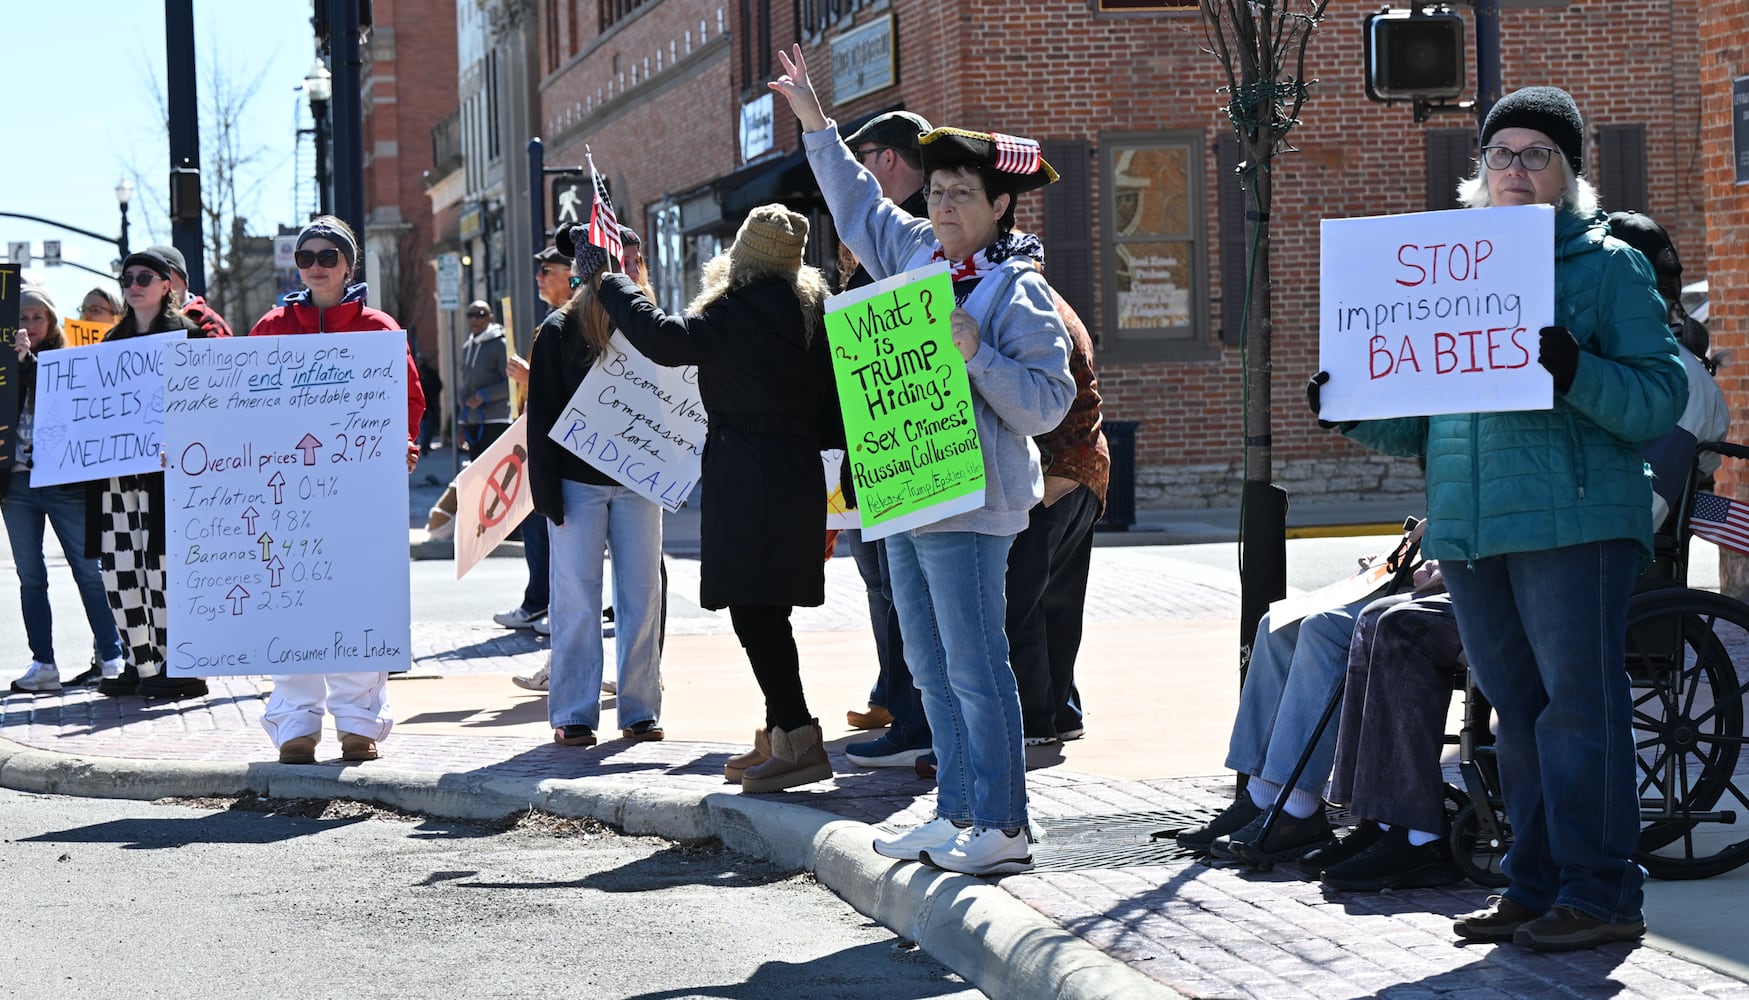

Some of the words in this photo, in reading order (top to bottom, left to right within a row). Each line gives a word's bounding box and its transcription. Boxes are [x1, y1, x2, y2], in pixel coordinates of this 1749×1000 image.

[1396, 239, 1493, 287] STOP
[844, 291, 913, 343] What
[1338, 288, 1521, 343] imprisoning
[267, 337, 305, 370] day
[851, 340, 937, 392] TRUMP
[874, 338, 895, 357] is
[1369, 327, 1529, 380] BABIES
[42, 357, 88, 393] THE
[167, 375, 200, 393] we
[208, 367, 243, 389] will
[249, 366, 284, 388] end
[293, 361, 355, 386] inflation
[363, 360, 394, 379] and
[603, 352, 673, 405] Becomes
[865, 364, 952, 421] Hiding?
[72, 397, 115, 422] ICE
[120, 390, 141, 416] IS
[166, 393, 219, 412] make
[227, 391, 281, 411] America
[290, 384, 350, 409] affordable
[598, 385, 704, 456] Compassion
[863, 427, 900, 454] Sex
[903, 400, 969, 442] Crimes?
[59, 432, 160, 470] MELTING
[181, 442, 253, 476] Overall
[258, 451, 298, 474] prices
[331, 432, 384, 464] 2.9%
[563, 418, 692, 505] RADICAL!
[615, 426, 667, 463] looks
[854, 458, 914, 489] Russian
[911, 428, 979, 469] Collusion?
[183, 486, 267, 510] Inflation
[299, 475, 339, 501] 0.4%
[866, 489, 905, 513] Release
[185, 517, 243, 541] Coffee
[185, 544, 257, 566] Bananas
[282, 537, 325, 558] 4.9%
[187, 570, 263, 590] Groceries
[292, 560, 333, 583] 0.6%
[189, 596, 226, 621] Toys
[257, 590, 306, 612] 2.5%
[174, 642, 257, 670] Source:
[267, 637, 330, 664] Consumer
[334, 631, 359, 661] Price
[363, 628, 401, 659] Index
